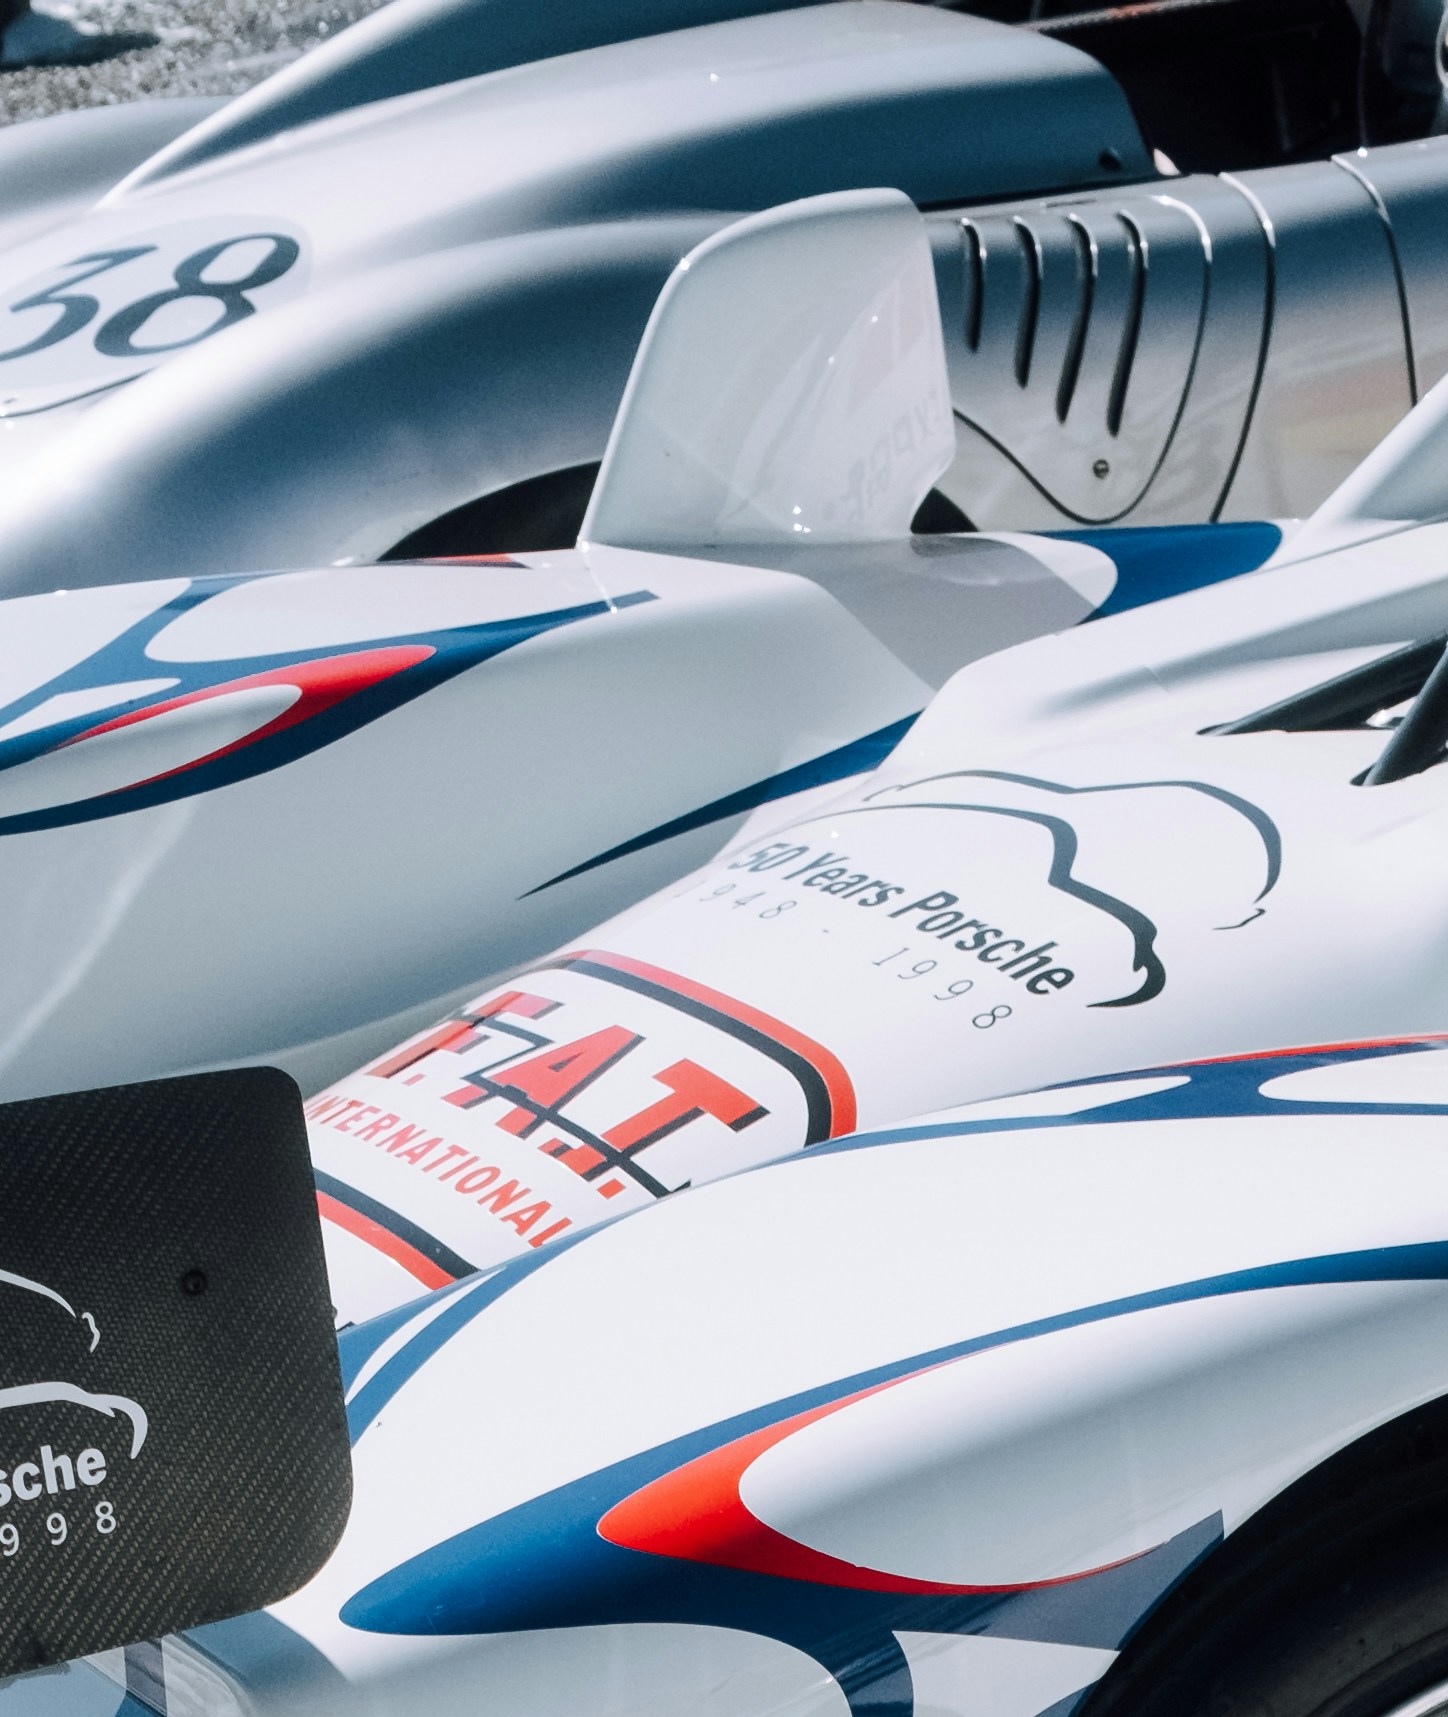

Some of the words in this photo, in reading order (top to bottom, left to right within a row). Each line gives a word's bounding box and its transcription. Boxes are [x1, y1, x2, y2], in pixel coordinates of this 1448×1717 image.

[0, 232, 300, 362] 38
[727, 843, 809, 872] 50
[781, 850, 905, 909] Years
[892, 889, 1076, 997] Porsche
[305, 1094, 573, 1248] INTERNATIONAL
